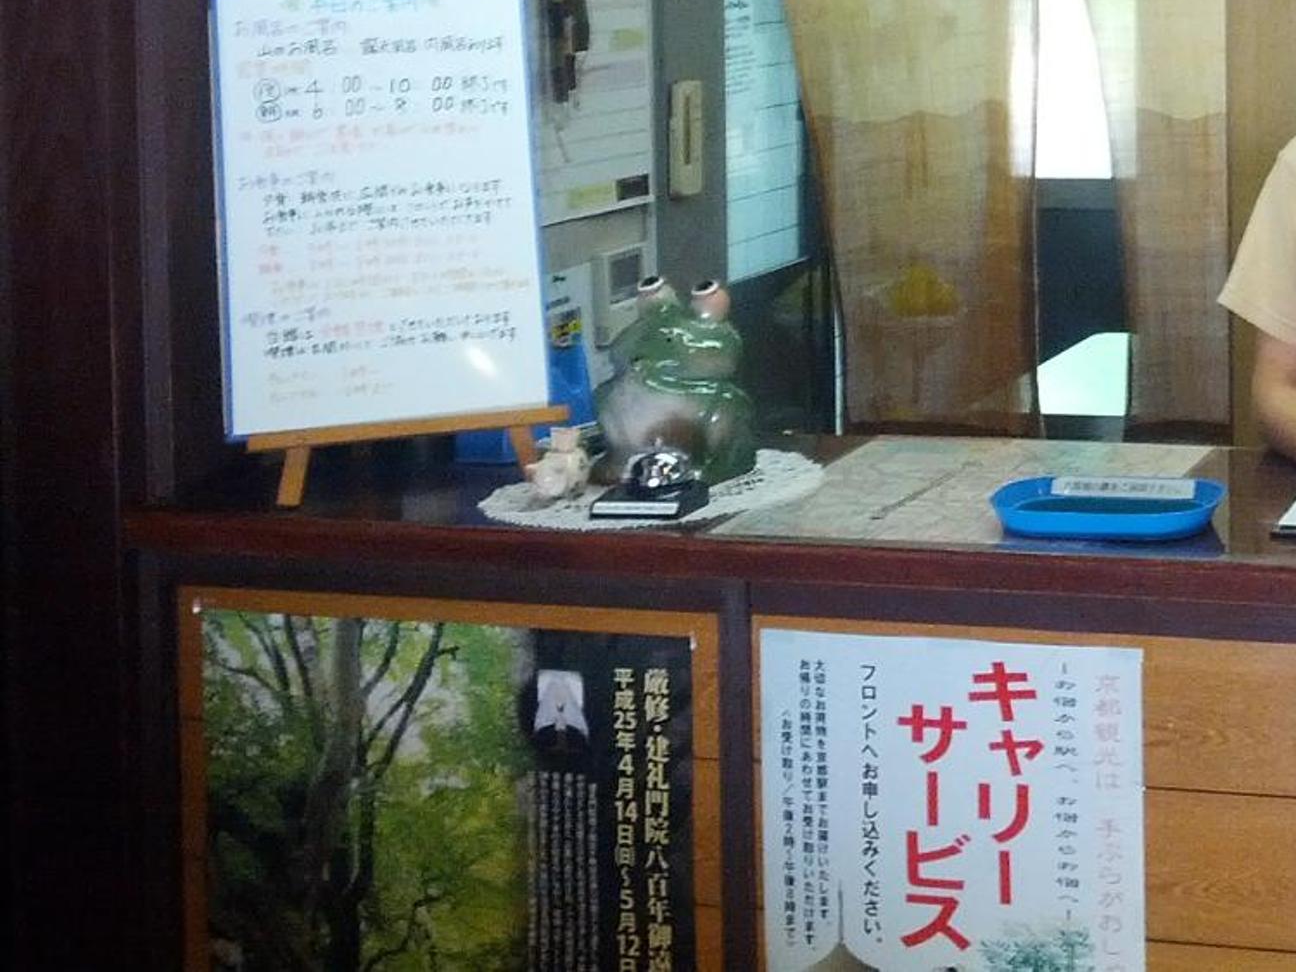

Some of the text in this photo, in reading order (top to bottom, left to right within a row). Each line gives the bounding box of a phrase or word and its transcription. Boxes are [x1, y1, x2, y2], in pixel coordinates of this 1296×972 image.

[860, 664, 883, 944] フロントへお申し込みください。
[897, 704, 972, 951] サービス
[966, 661, 1045, 905] キャリー
